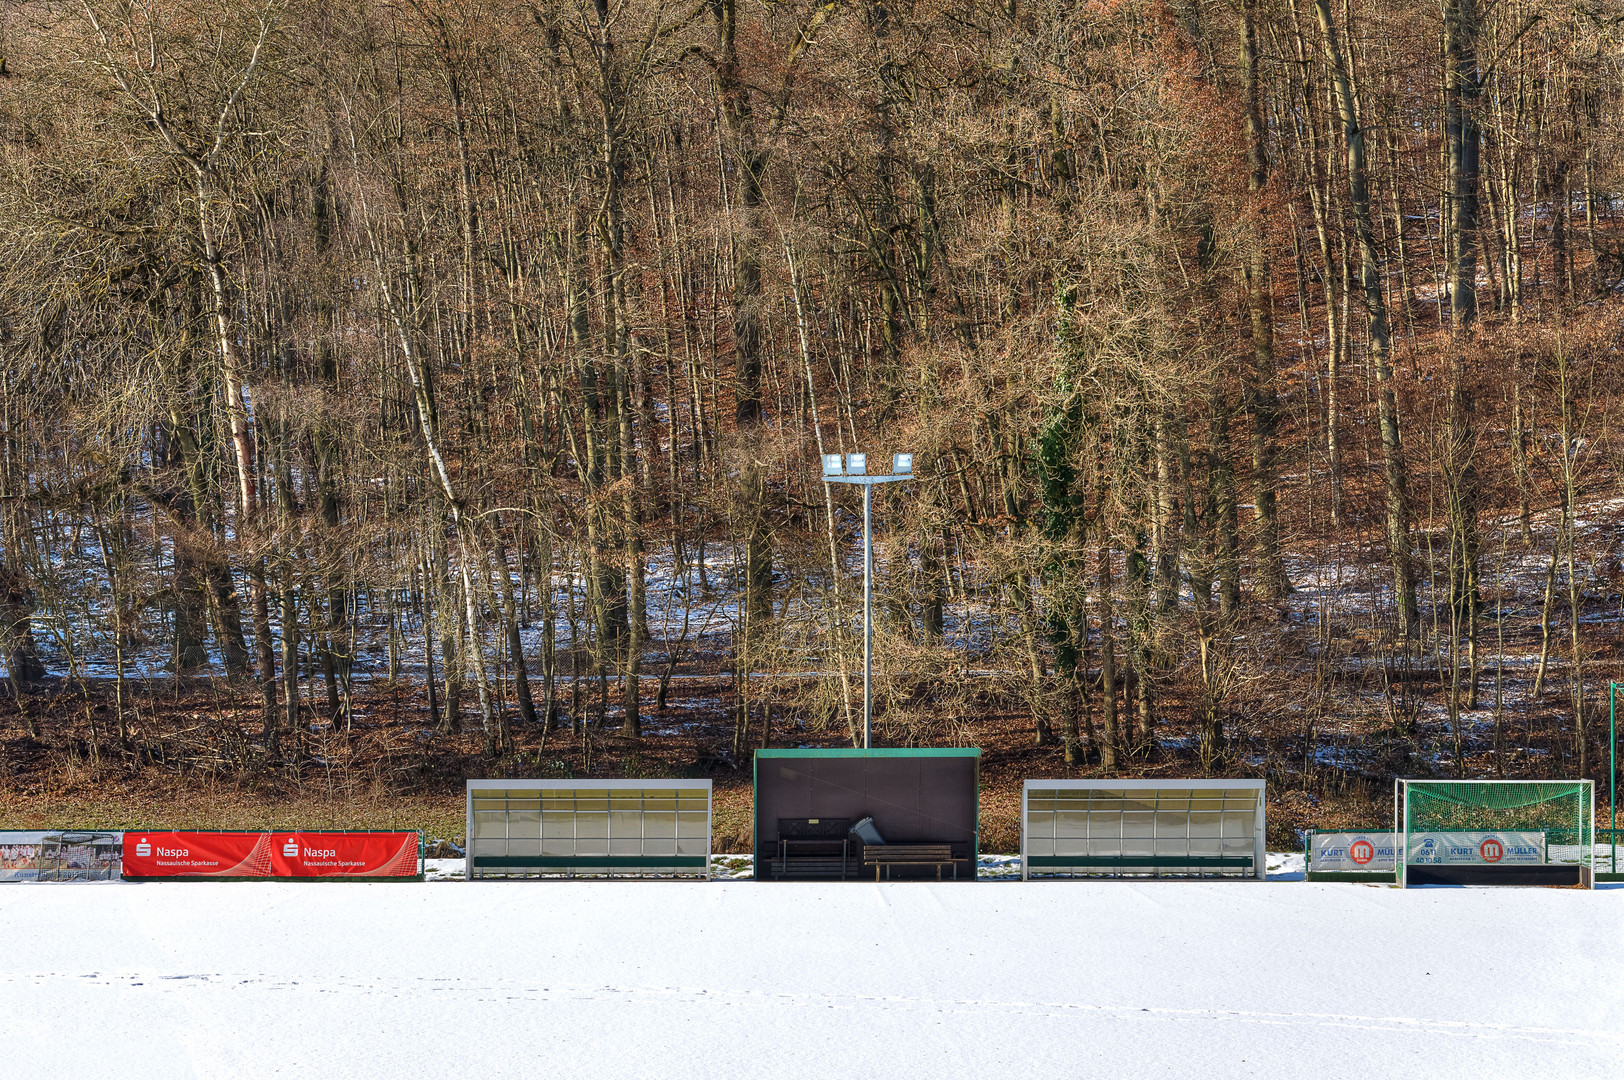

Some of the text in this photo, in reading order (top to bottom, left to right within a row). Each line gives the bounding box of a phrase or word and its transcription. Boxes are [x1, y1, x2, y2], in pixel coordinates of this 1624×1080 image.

[156, 847, 189, 858] Naspa
[303, 848, 336, 859] Naspa
[1507, 847, 1537, 855] MÜLLER
